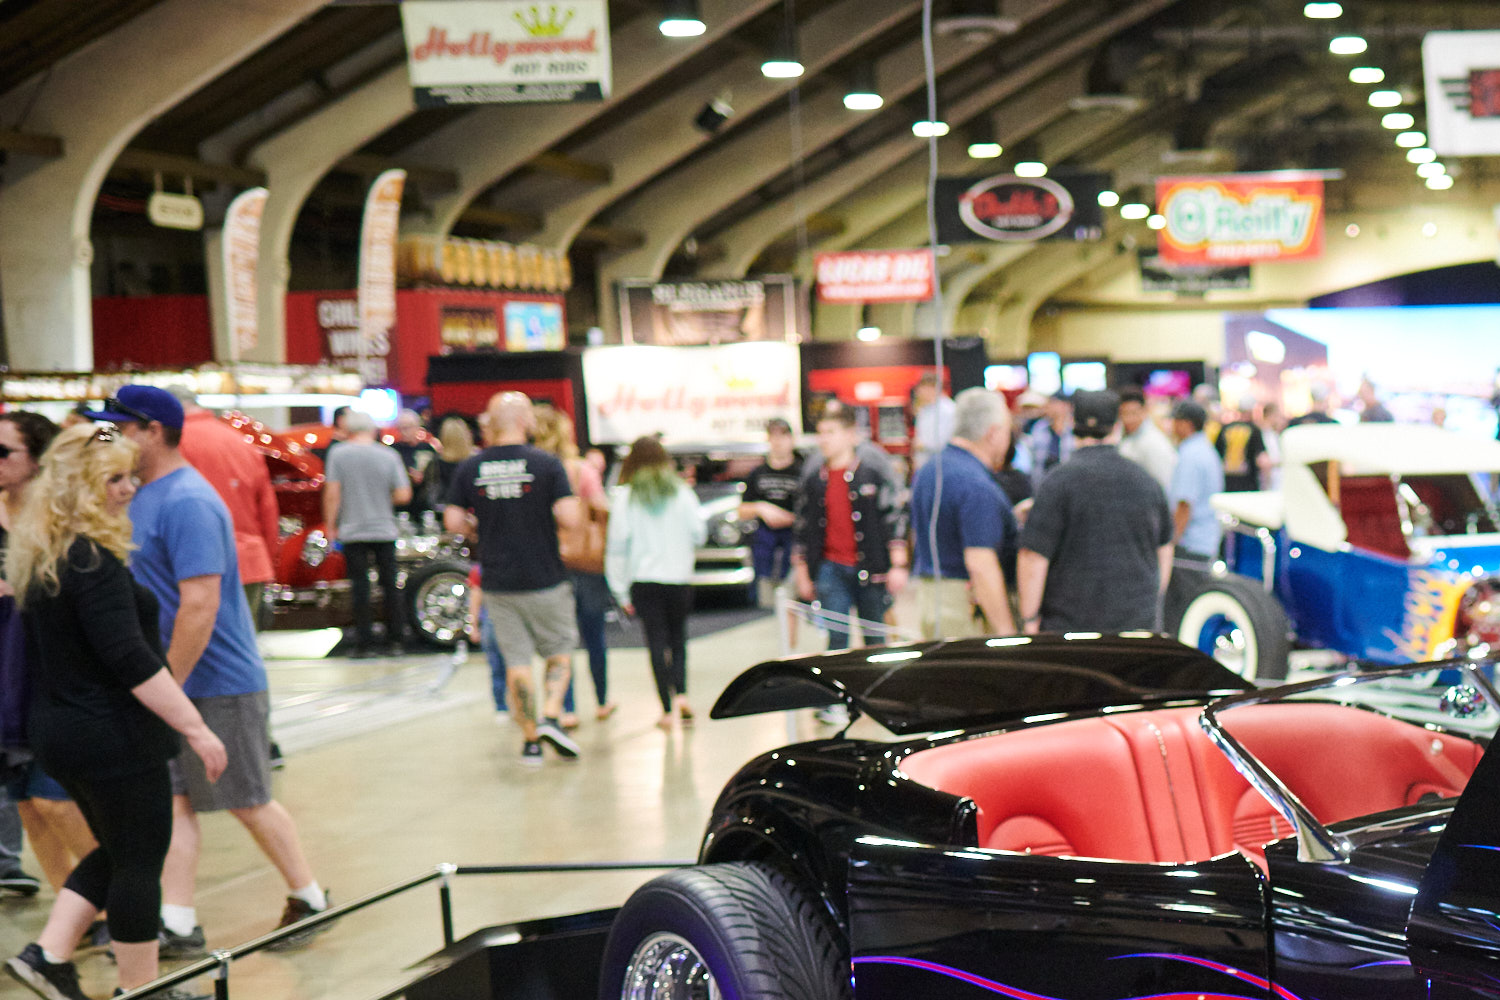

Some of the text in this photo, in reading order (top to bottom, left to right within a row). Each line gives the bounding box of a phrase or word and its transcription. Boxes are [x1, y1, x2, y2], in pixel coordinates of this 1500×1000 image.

[414, 27, 596, 65] Hollywood
[1168, 188, 1312, 245] O'Reilly
[598, 381, 790, 418] Hollywood
